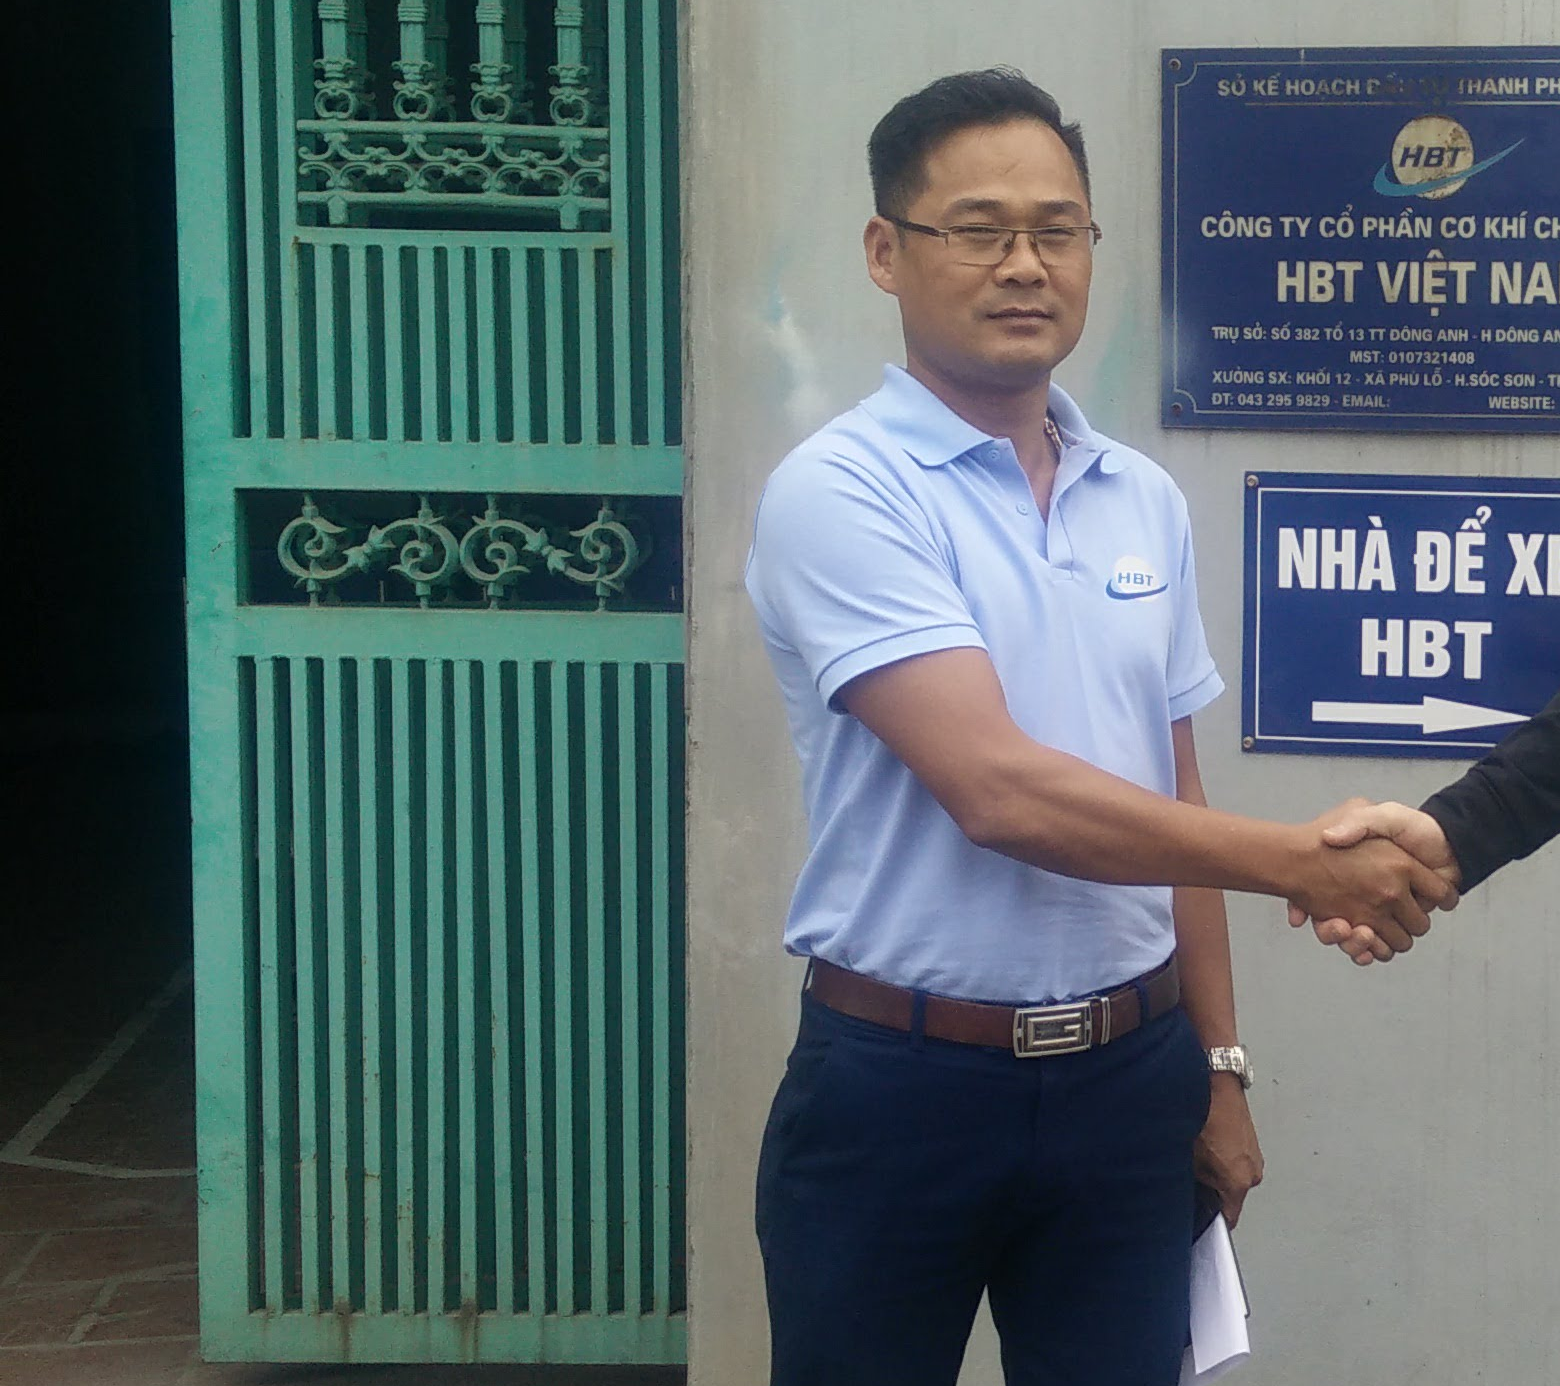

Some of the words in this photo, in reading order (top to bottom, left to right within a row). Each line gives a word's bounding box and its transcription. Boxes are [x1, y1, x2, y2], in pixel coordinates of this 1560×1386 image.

[1252, 72, 1281, 96] KẾ
[1398, 145, 1467, 168] HBT
[1201, 210, 1273, 238] CÔNG
[1279, 216, 1311, 238] TY
[1319, 205, 1355, 239] CỔ
[1362, 207, 1433, 239] PHẦN
[1440, 214, 1478, 239] CƠ
[1484, 211, 1527, 239] KHÍ
[1276, 260, 1364, 303] HBT
[1376, 249, 1477, 316] VIỆT
[1211, 326, 1239, 344] TRỤ
[1271, 321, 1291, 341] SỐ
[1295, 328, 1320, 341] 382
[1323, 321, 1343, 341] TỔ
[1348, 328, 1365, 341] 13
[1368, 328, 1386, 341] TT
[1437, 329, 1469, 342] ANH
[1481, 330, 1492, 343] H
[1349, 351, 1385, 364] MST:
[1388, 351, 1475, 364] 0107321408
[1268, 371, 1292, 384] SX:
[1296, 367, 1331, 385] KHỐI
[1335, 373, 1351, 385] 12
[1455, 370, 1499, 387] H.SÓC
[1503, 373, 1535, 387] SƠN
[1237, 394, 1263, 406] 043
[1266, 394, 1292, 406] 295
[1296, 395, 1331, 407] 9829
[1342, 395, 1390, 408] EMAIL:
[1488, 396, 1555, 409] WEBSITE:
[1278, 515, 1396, 591] NHÀ
[1413, 505, 1491, 594] ĐỂ
[1117, 572, 1154, 586] HBT
[1361, 618, 1492, 680] HBT
